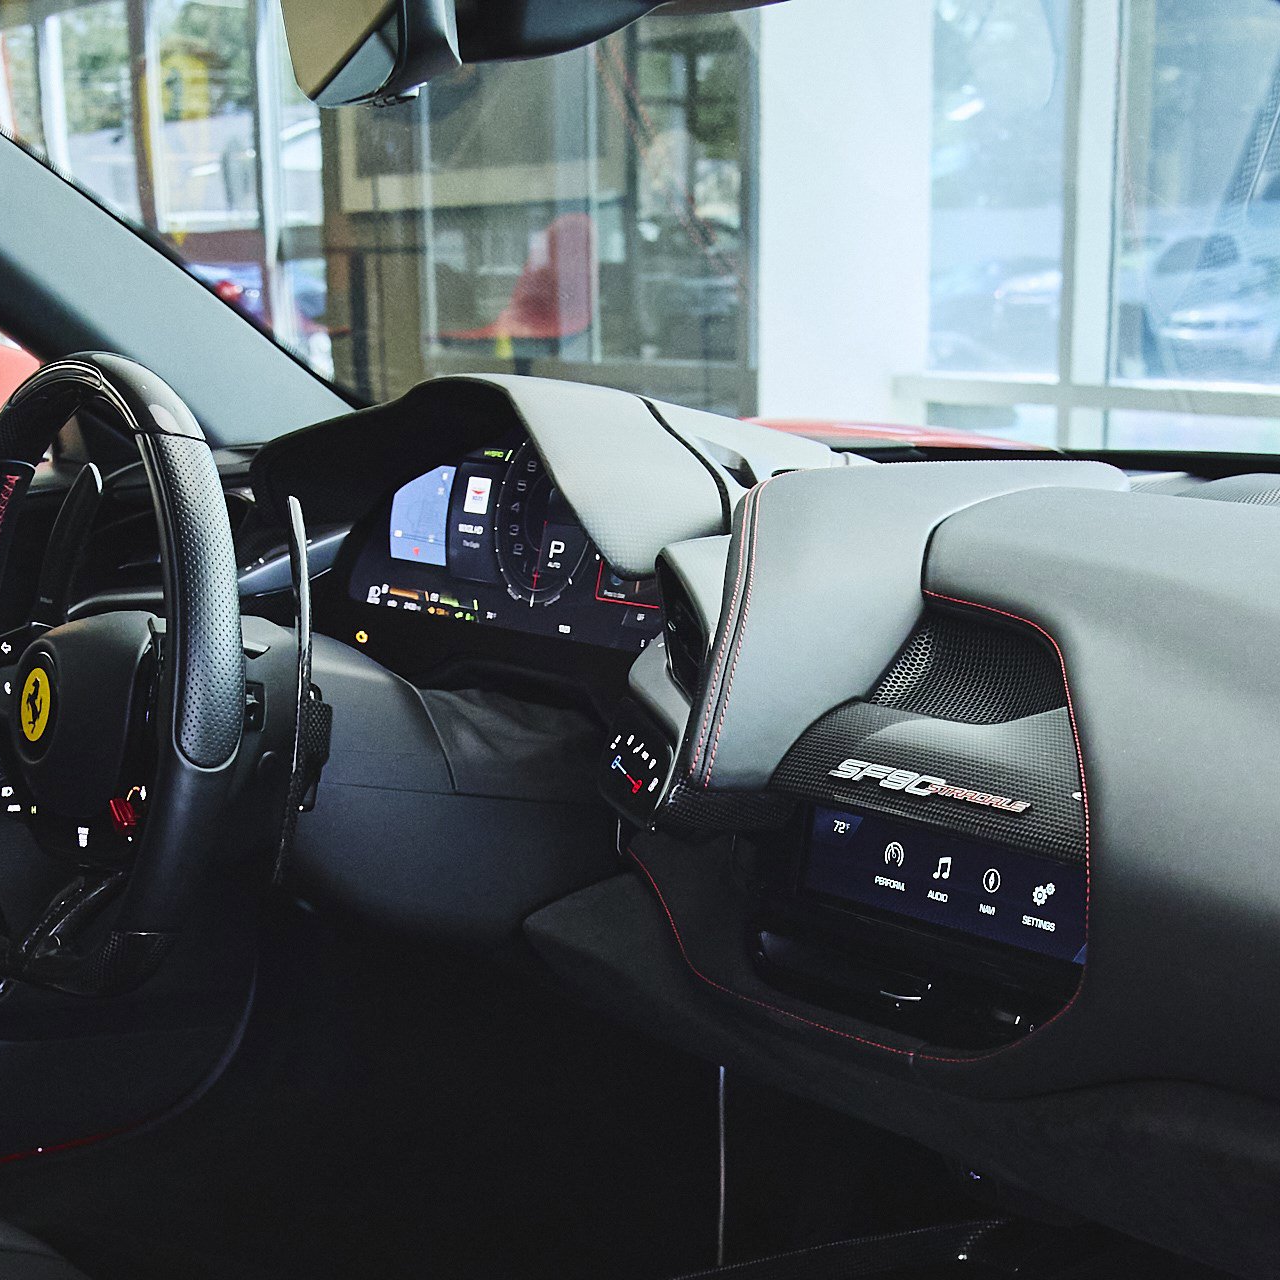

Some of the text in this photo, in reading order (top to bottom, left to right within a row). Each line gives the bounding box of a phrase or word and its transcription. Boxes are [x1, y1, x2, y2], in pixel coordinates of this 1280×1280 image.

[510, 502, 521, 513] 4
[548, 540, 566, 559] P
[926, 889, 949, 903] AUDIO
[979, 903, 996, 916] NAVI
[1021, 914, 1056, 932] SETTINGS
